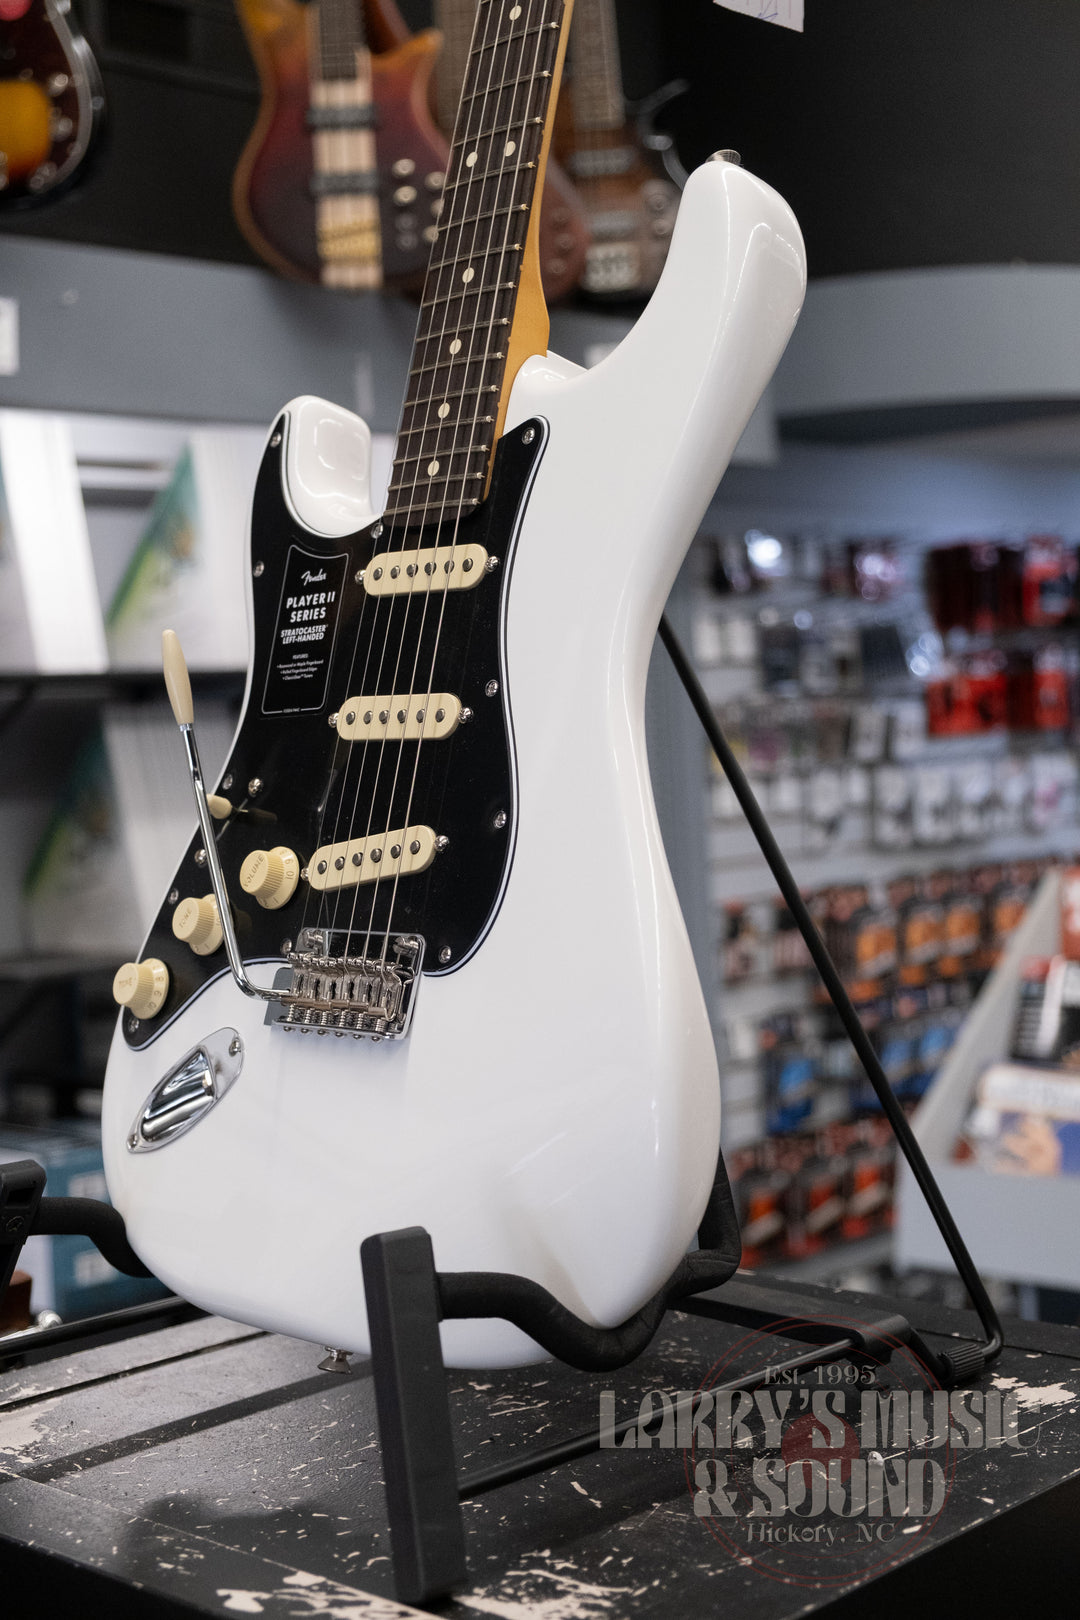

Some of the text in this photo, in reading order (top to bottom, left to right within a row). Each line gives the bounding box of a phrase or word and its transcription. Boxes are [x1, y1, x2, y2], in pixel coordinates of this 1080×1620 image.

[286, 591, 336, 609] PLAYER II
[289, 606, 327, 623] SERIES
[282, 632, 325, 645] LEFT-HANDED
